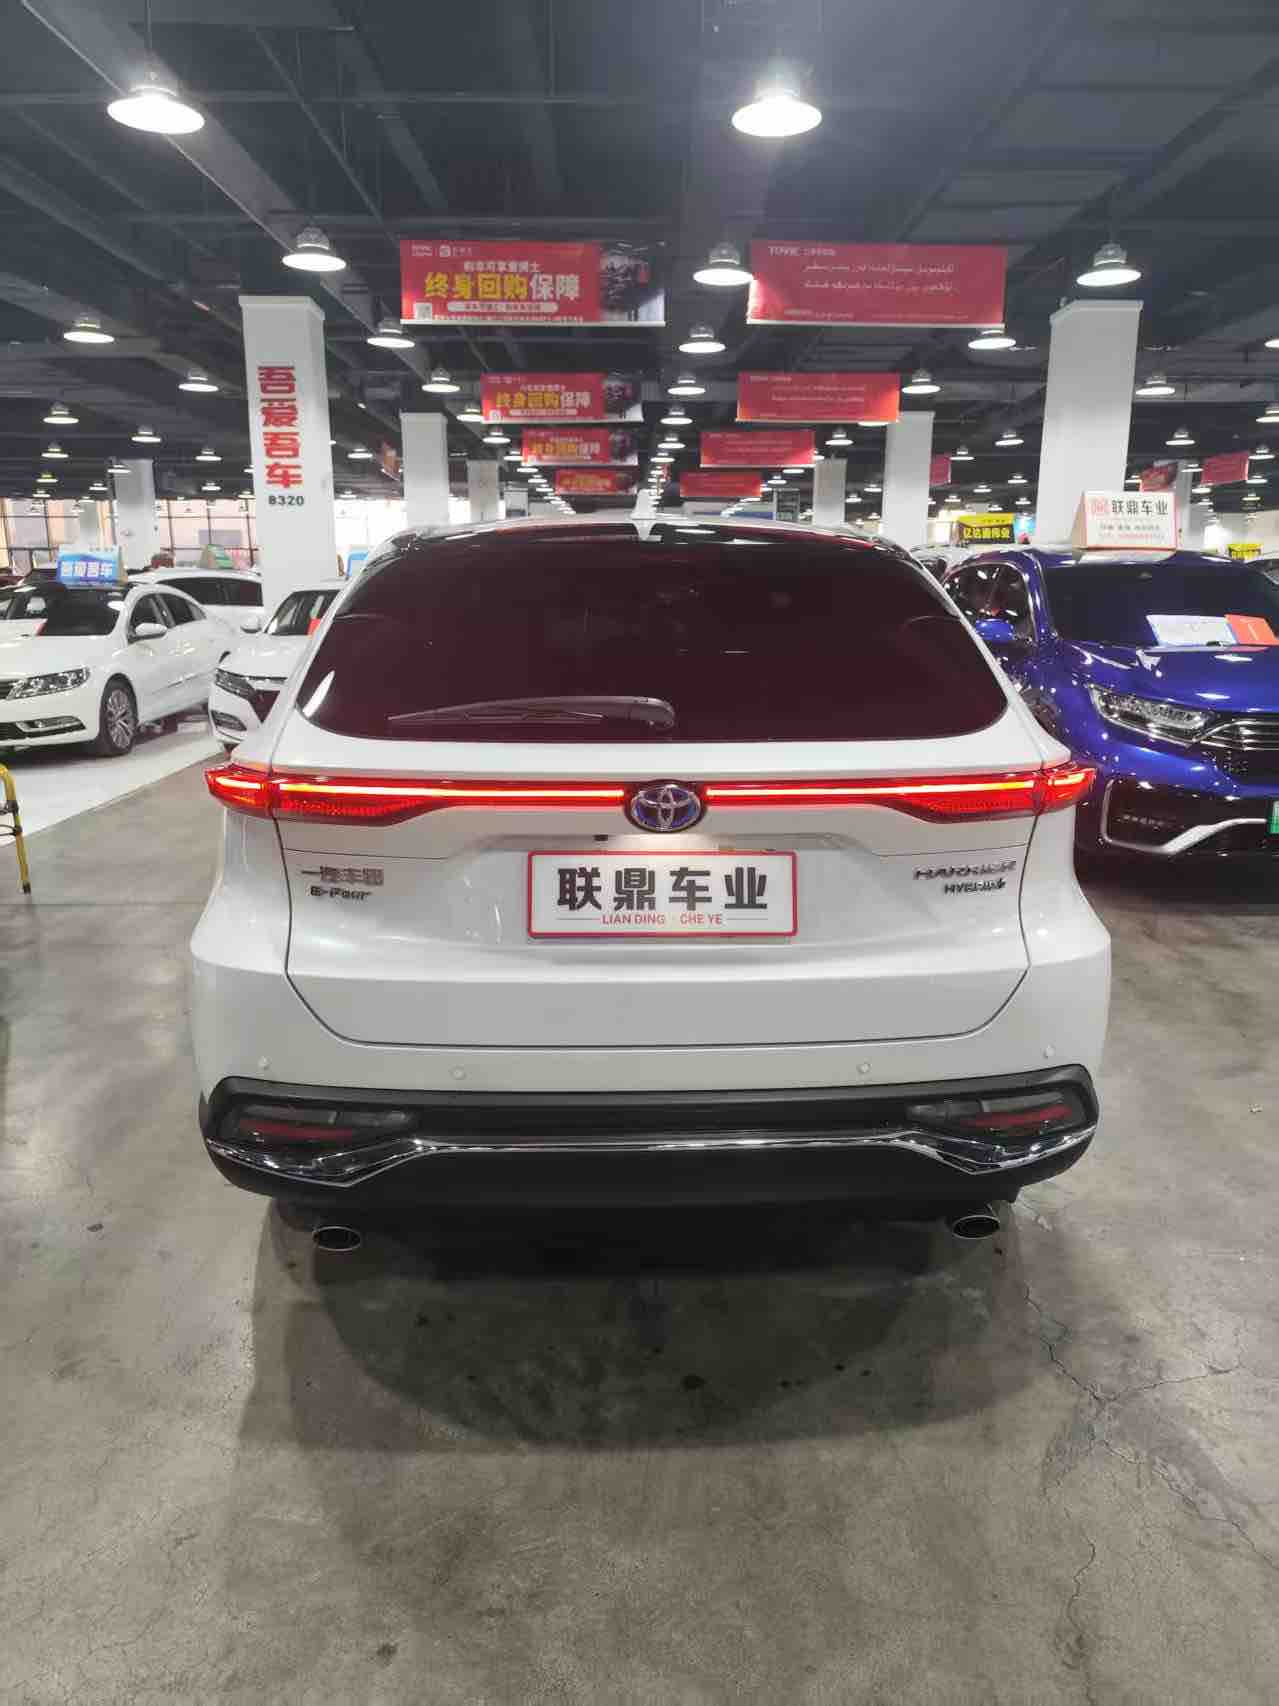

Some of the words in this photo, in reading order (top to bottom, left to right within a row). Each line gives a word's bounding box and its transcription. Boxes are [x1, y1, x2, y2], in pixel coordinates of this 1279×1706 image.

[424, 272, 579, 300] 终身回购保障
[1111, 499, 1169, 516] 联鼎车业
[556, 866, 768, 911] 联鼎车业
[602, 913, 632, 925] LIAN
[634, 913, 665, 925] DING
[680, 913, 705, 925] CHE
[709, 913, 723, 925] YE
